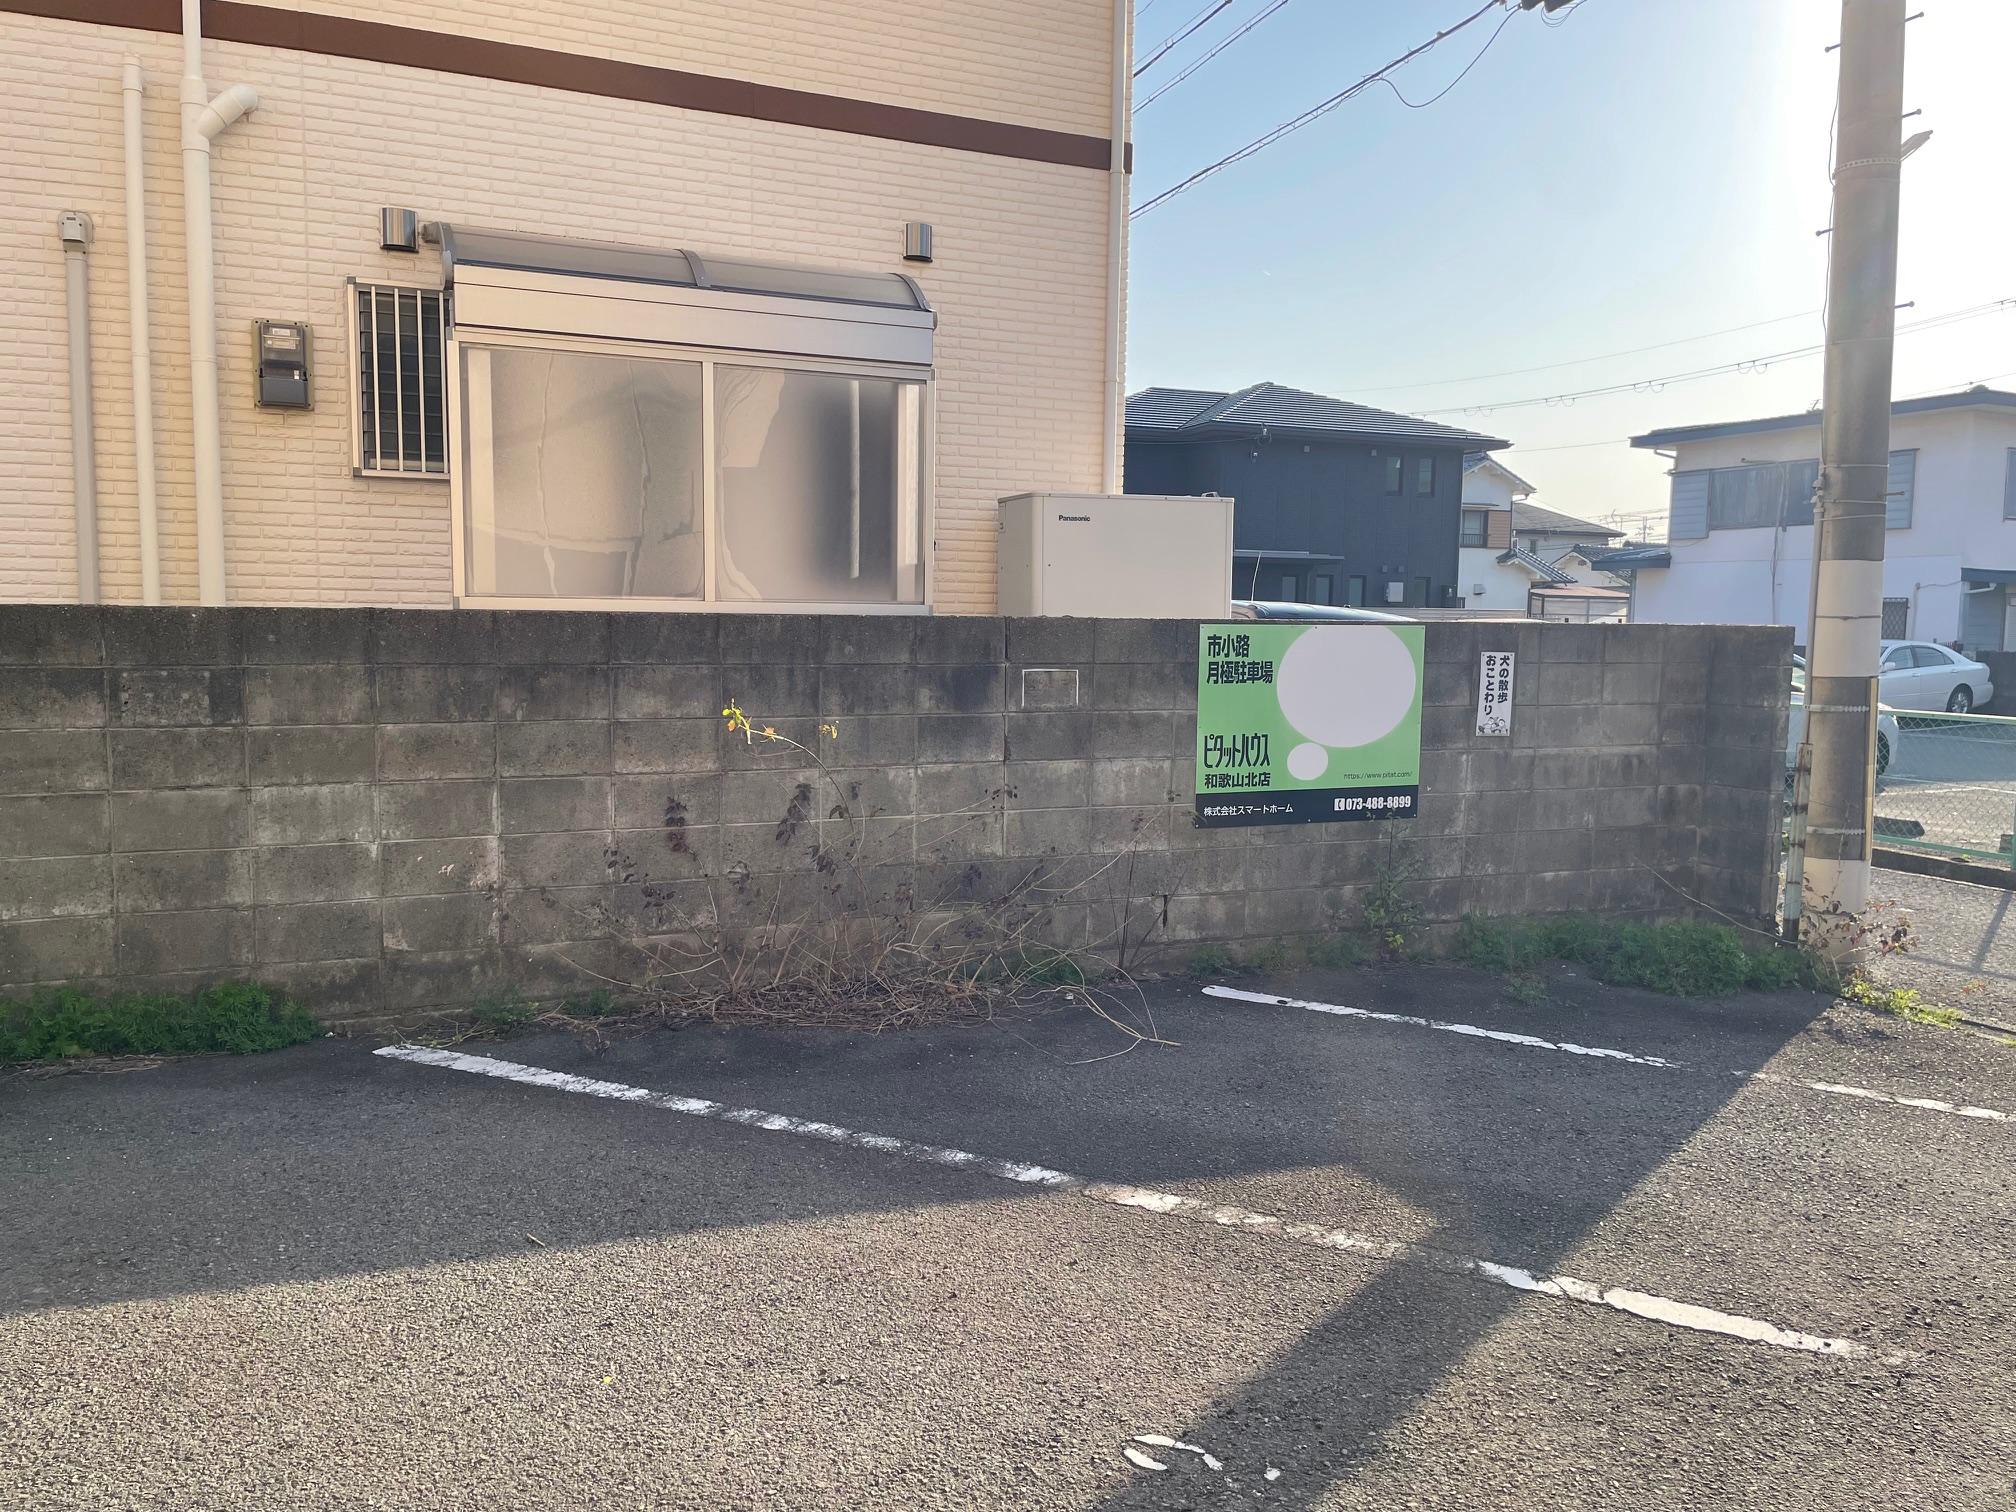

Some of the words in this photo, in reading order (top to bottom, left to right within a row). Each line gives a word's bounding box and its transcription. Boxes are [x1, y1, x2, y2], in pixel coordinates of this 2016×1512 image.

[1058, 514, 1091, 522] Panasonic
[1207, 634, 1250, 658] 市小路
[1206, 660, 1274, 685] 月極駐車場
[1497, 654, 1511, 704] 犬の散歩
[1484, 654, 1497, 716] おことわり
[1203, 732, 1271, 769] ピタットハウス
[1204, 772, 1271, 789] 和歌山北店
[1203, 803, 1294, 817] 株式会社スマートホーム
[1345, 795, 1412, 811] 073-488-8899
